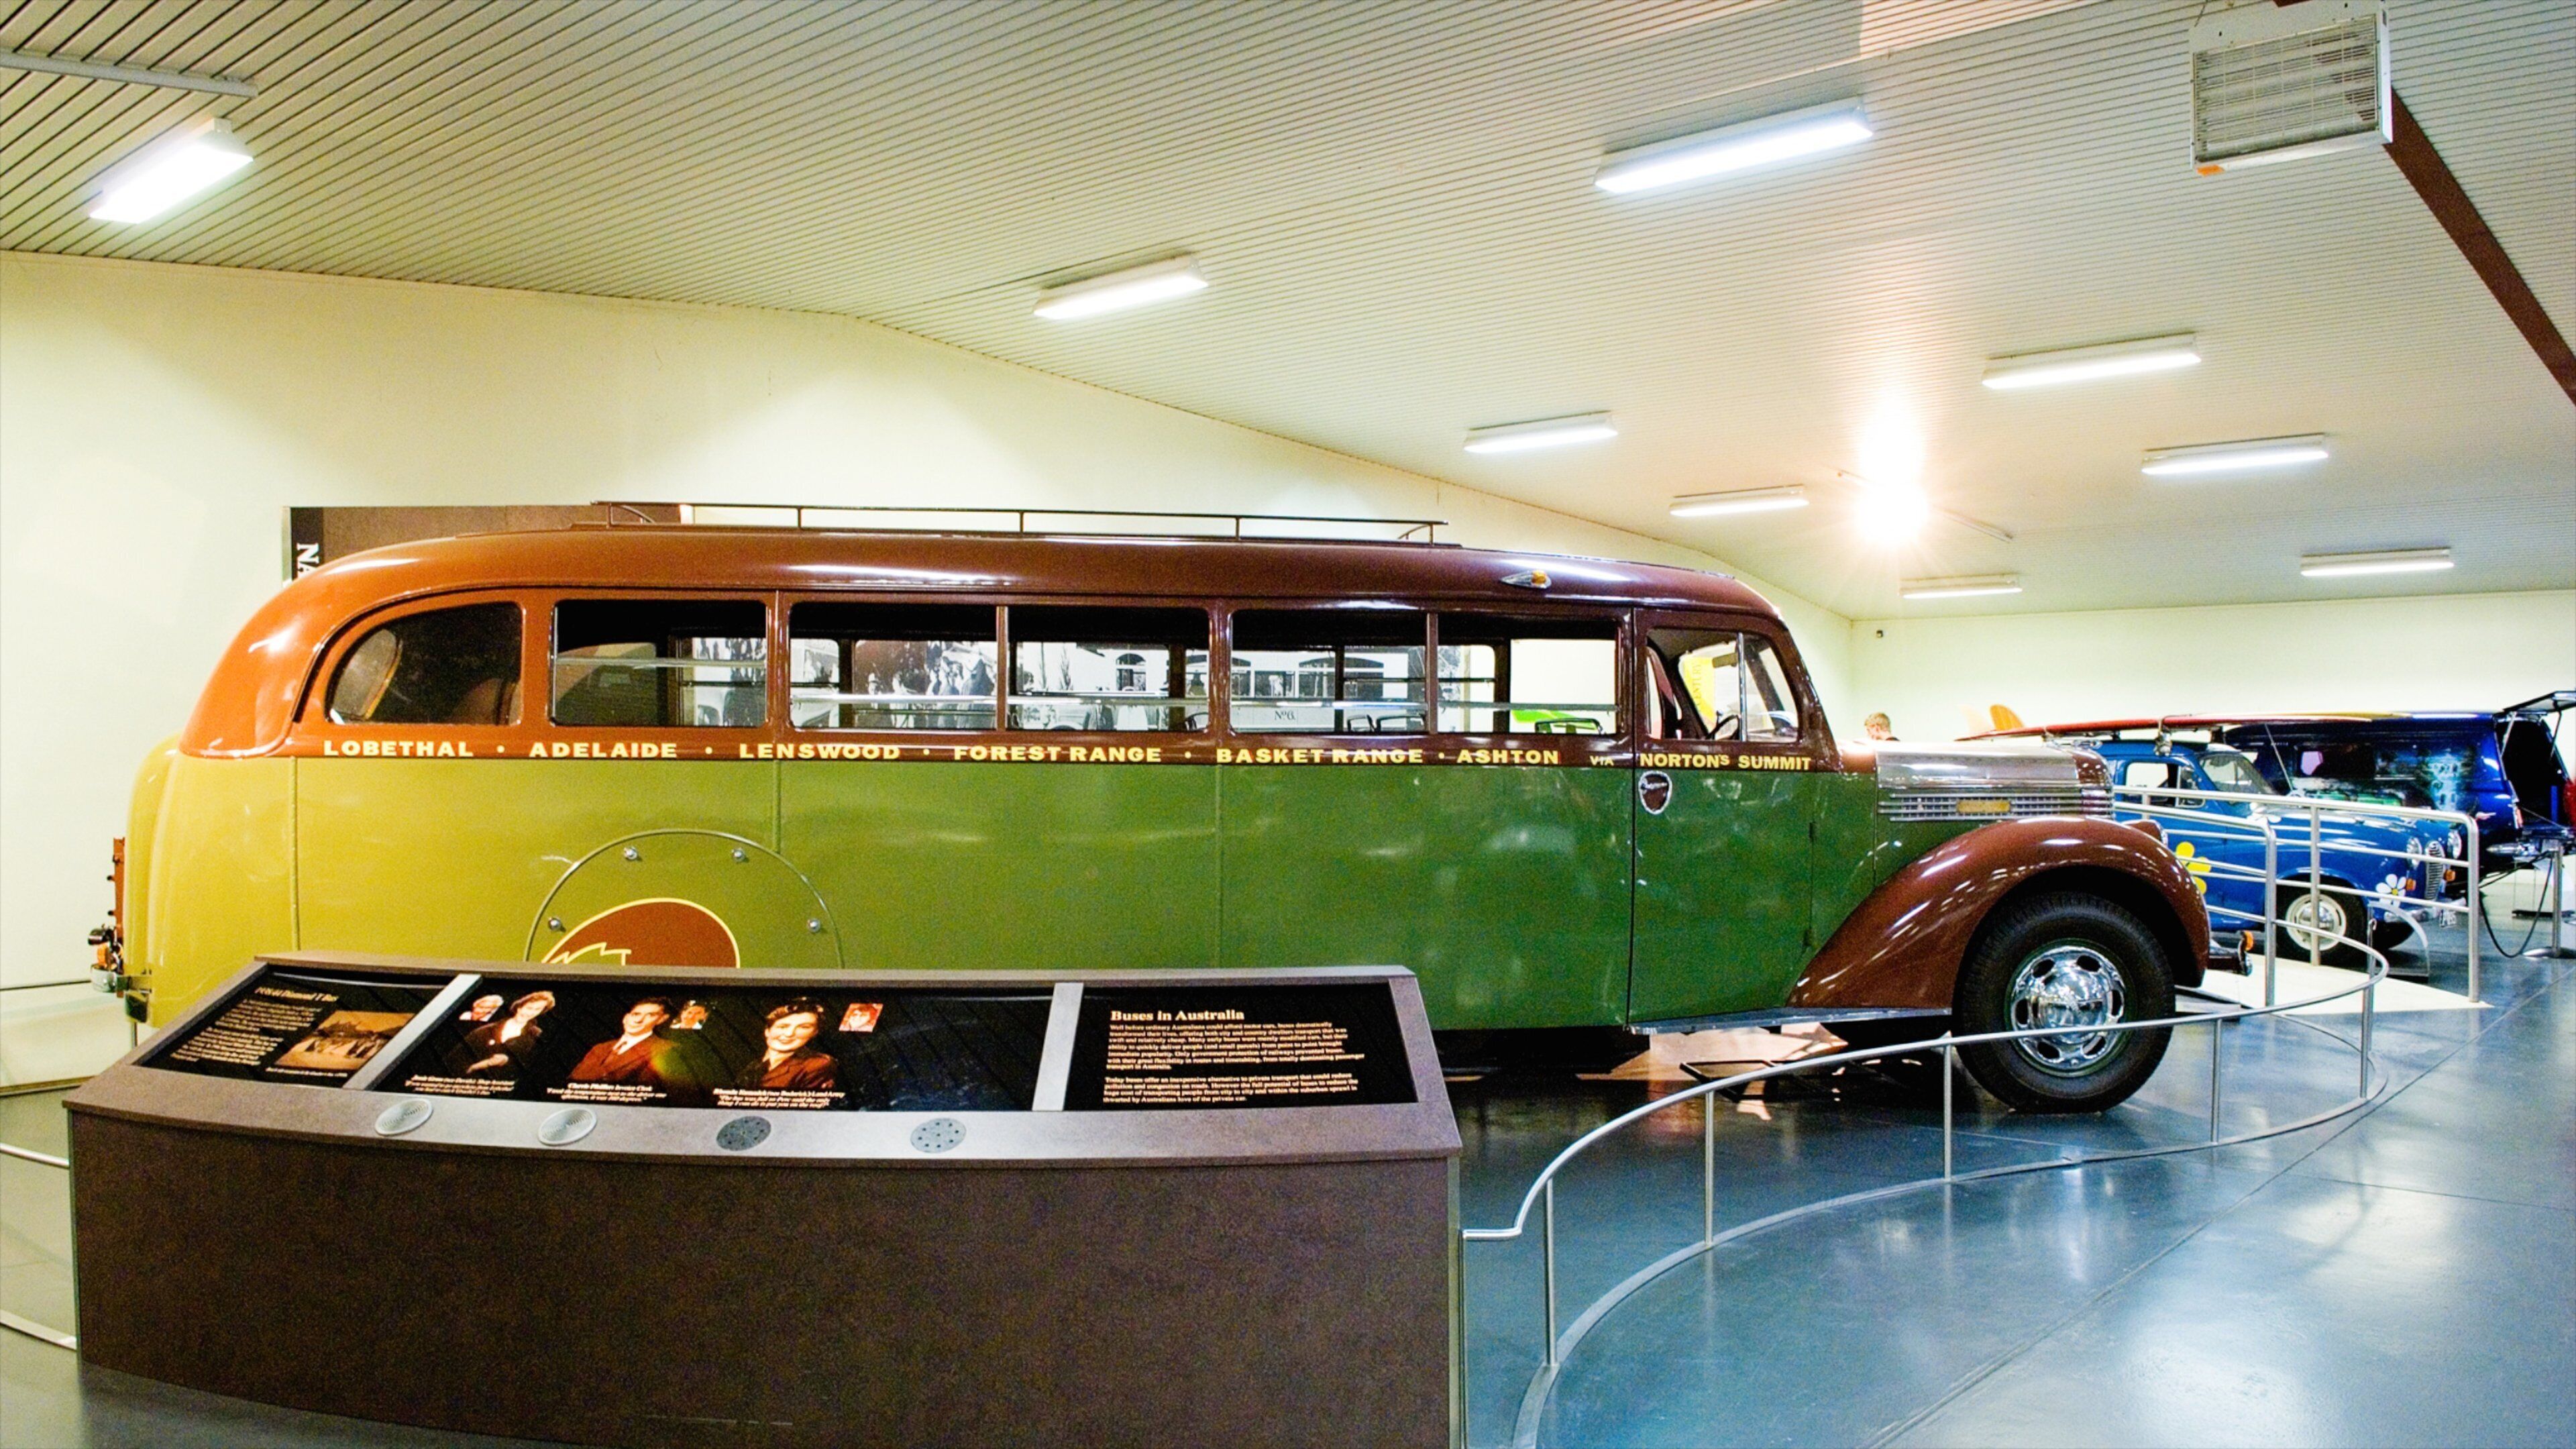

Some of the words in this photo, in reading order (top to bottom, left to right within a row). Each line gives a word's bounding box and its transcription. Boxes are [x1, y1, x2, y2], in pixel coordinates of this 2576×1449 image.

[323, 740, 474, 757] LOBETHAL
[529, 742, 678, 757] ADELAIDE
[739, 743, 901, 759] LENSWOOD
[954, 745, 1061, 761] FOREST
[1069, 747, 1161, 762] RANGE
[1216, 749, 1326, 763] BASKET
[1332, 749, 1423, 763] RANGE
[1456, 749, 1558, 764] ASHTON
[1590, 755, 1614, 766] VIA
[1738, 756, 1811, 770] SUMMIT
[1110, 1011, 1154, 1021] Buses
[1157, 1010, 1172, 1021] in
[1175, 1010, 1244, 1021] Australia
